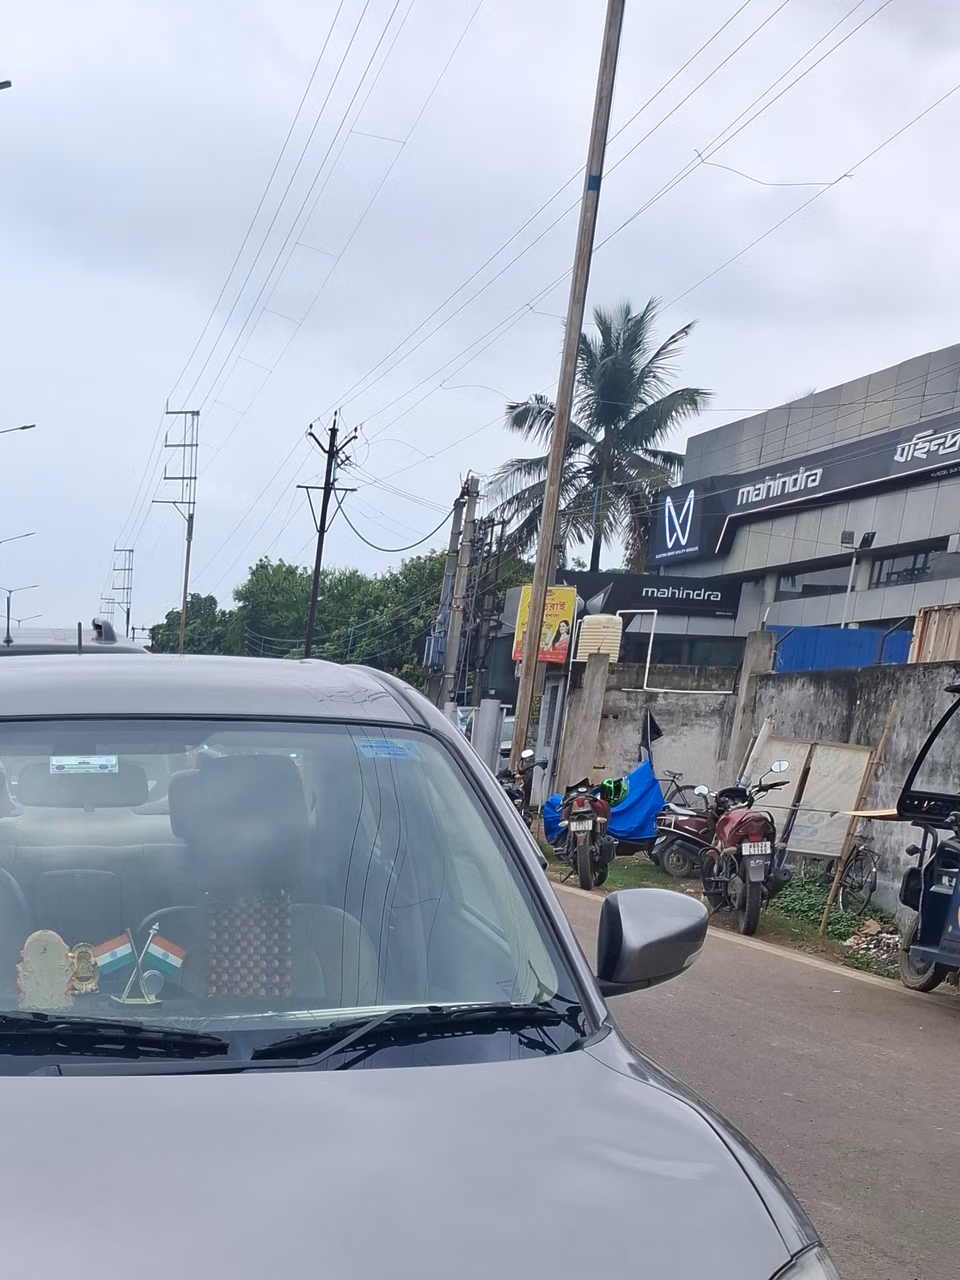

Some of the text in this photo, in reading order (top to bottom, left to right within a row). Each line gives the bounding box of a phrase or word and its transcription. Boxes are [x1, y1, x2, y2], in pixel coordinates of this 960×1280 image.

[894, 429, 960, 462] মহিন্দ্র
[737, 467, 823, 505] mahindra
[642, 586, 721, 600] mahindra
